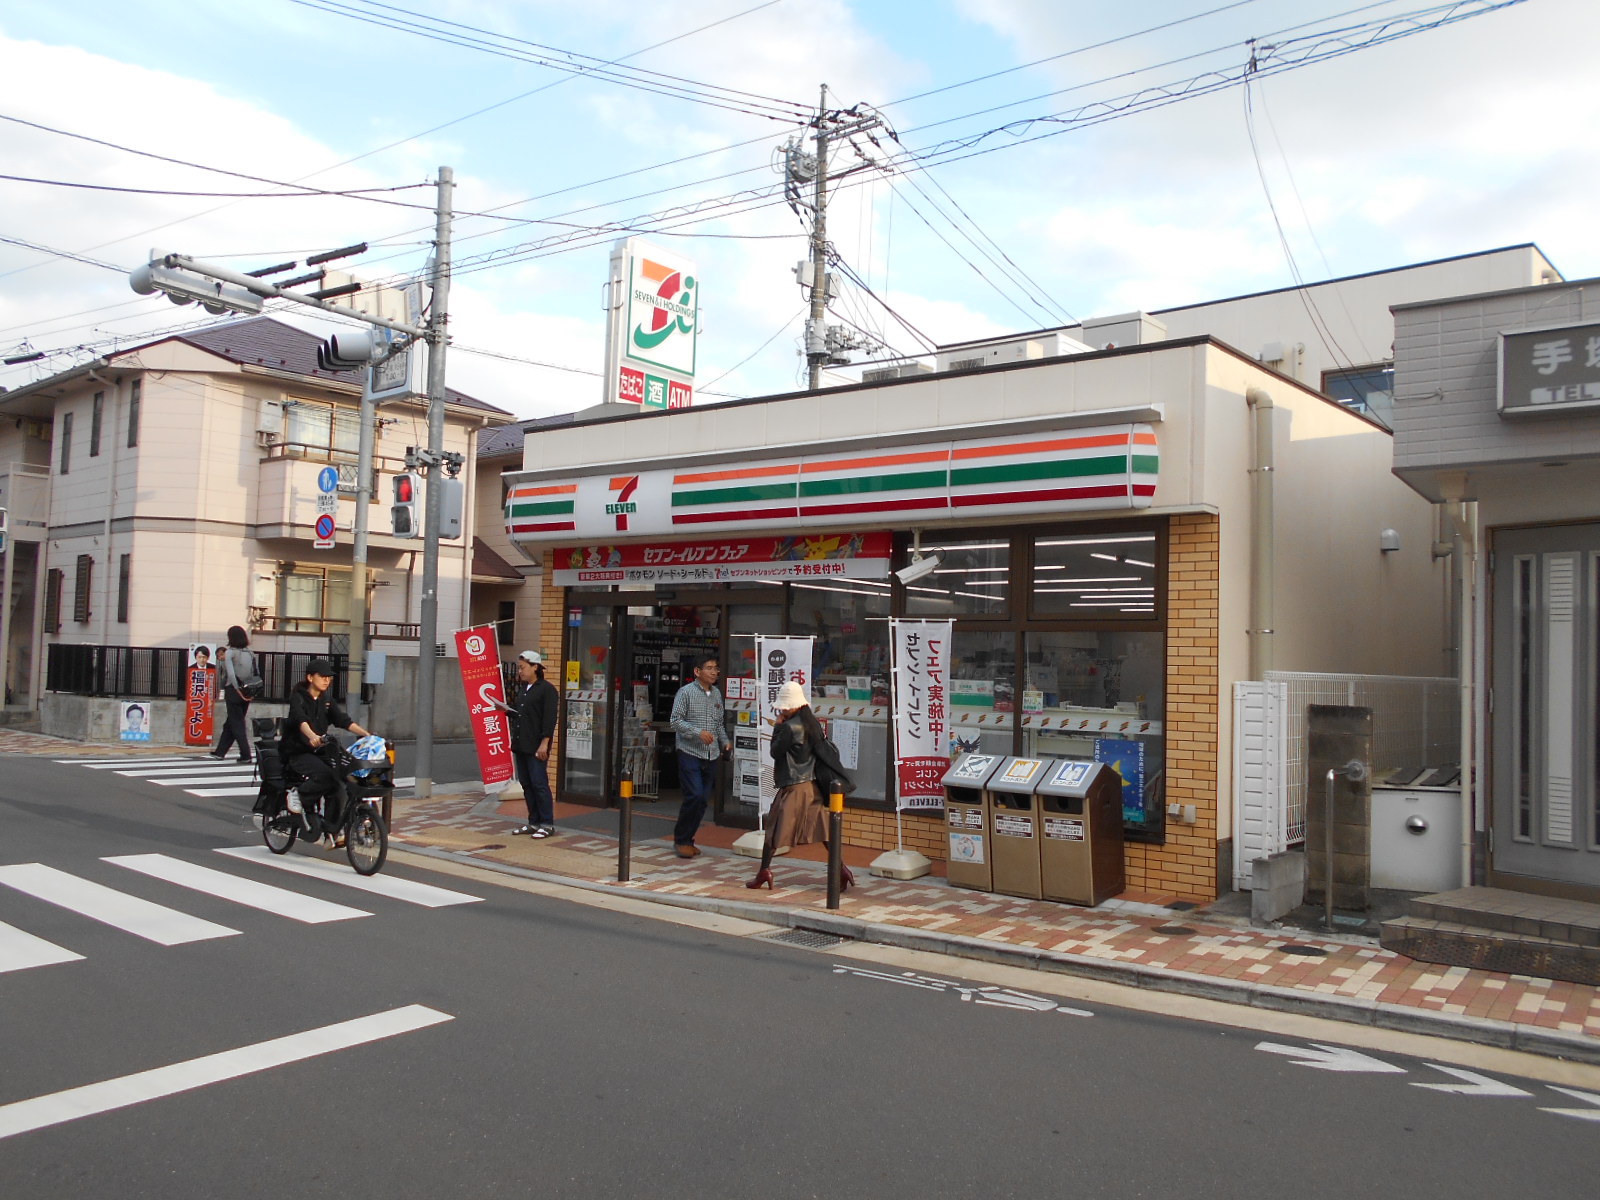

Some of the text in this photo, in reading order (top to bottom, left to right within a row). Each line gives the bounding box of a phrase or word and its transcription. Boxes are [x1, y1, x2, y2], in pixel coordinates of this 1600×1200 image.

[663, 301, 695, 319] HOLDINGS
[620, 372, 643, 398] たばこ
[648, 379, 664, 404] 酒
[1546, 384, 1594, 401] TEL
[669, 387, 691, 408] ATM
[719, 544, 749, 560] フェア
[189, 670, 207, 738] 福沢つよし
